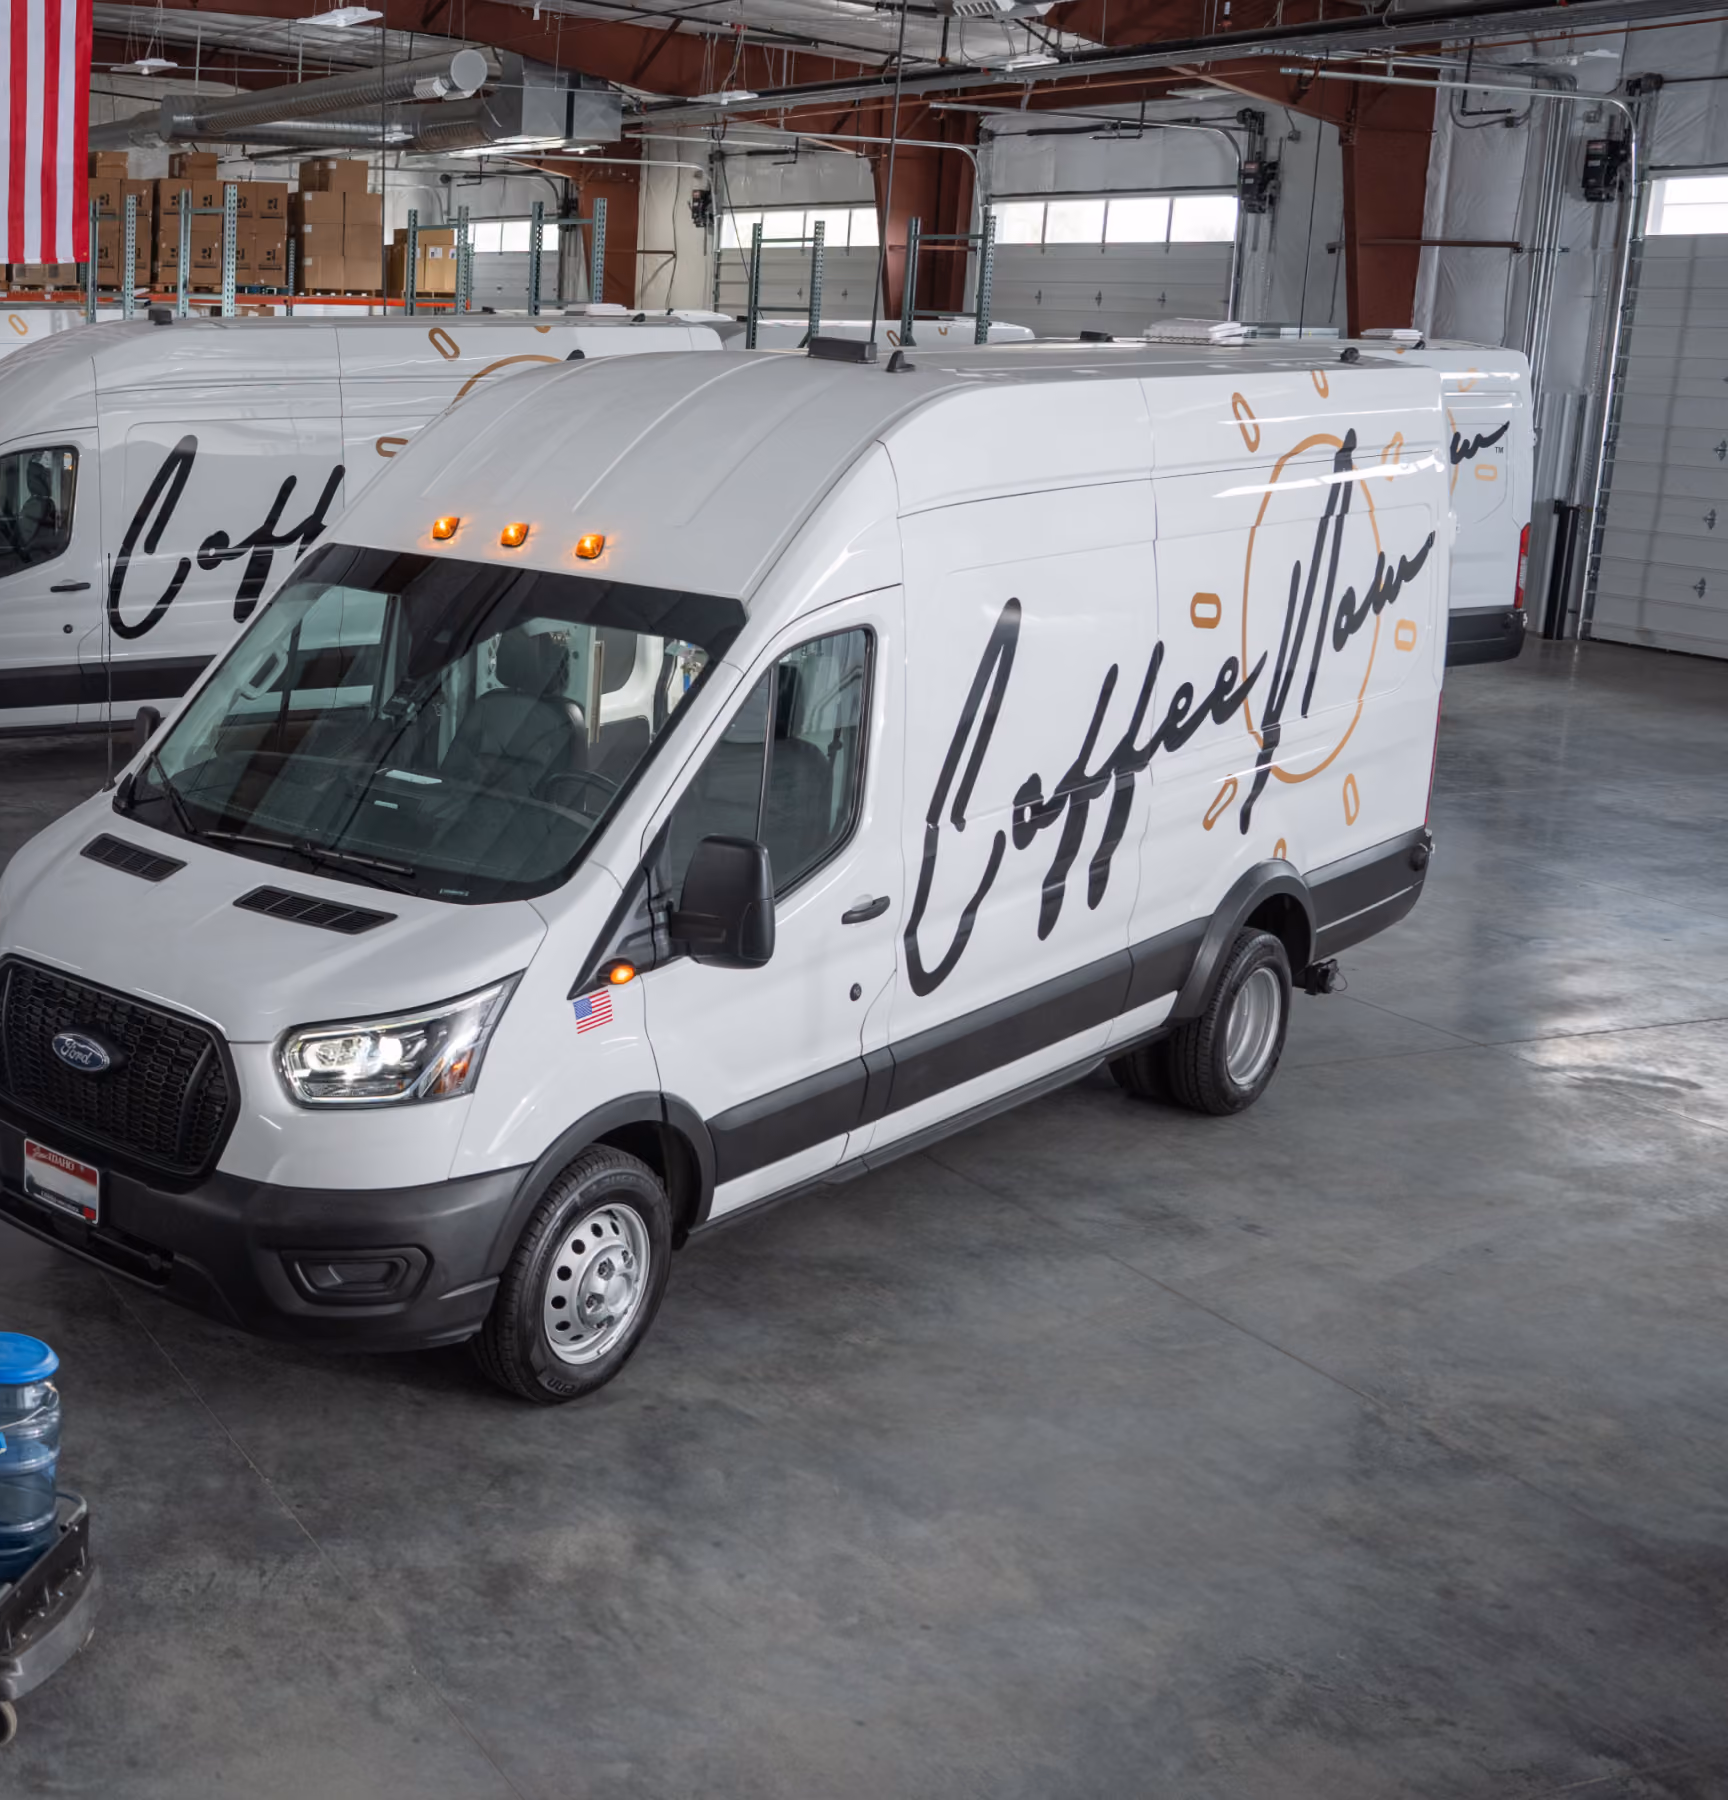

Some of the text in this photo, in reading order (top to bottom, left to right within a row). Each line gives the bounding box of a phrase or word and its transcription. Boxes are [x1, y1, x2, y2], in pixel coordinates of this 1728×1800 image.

[107, 434, 345, 640] Coff
[903, 428, 1436, 997] Coffee Now
[60, 1038, 91, 1065] Ford
[49, 1153, 75, 1171] IDAHO
